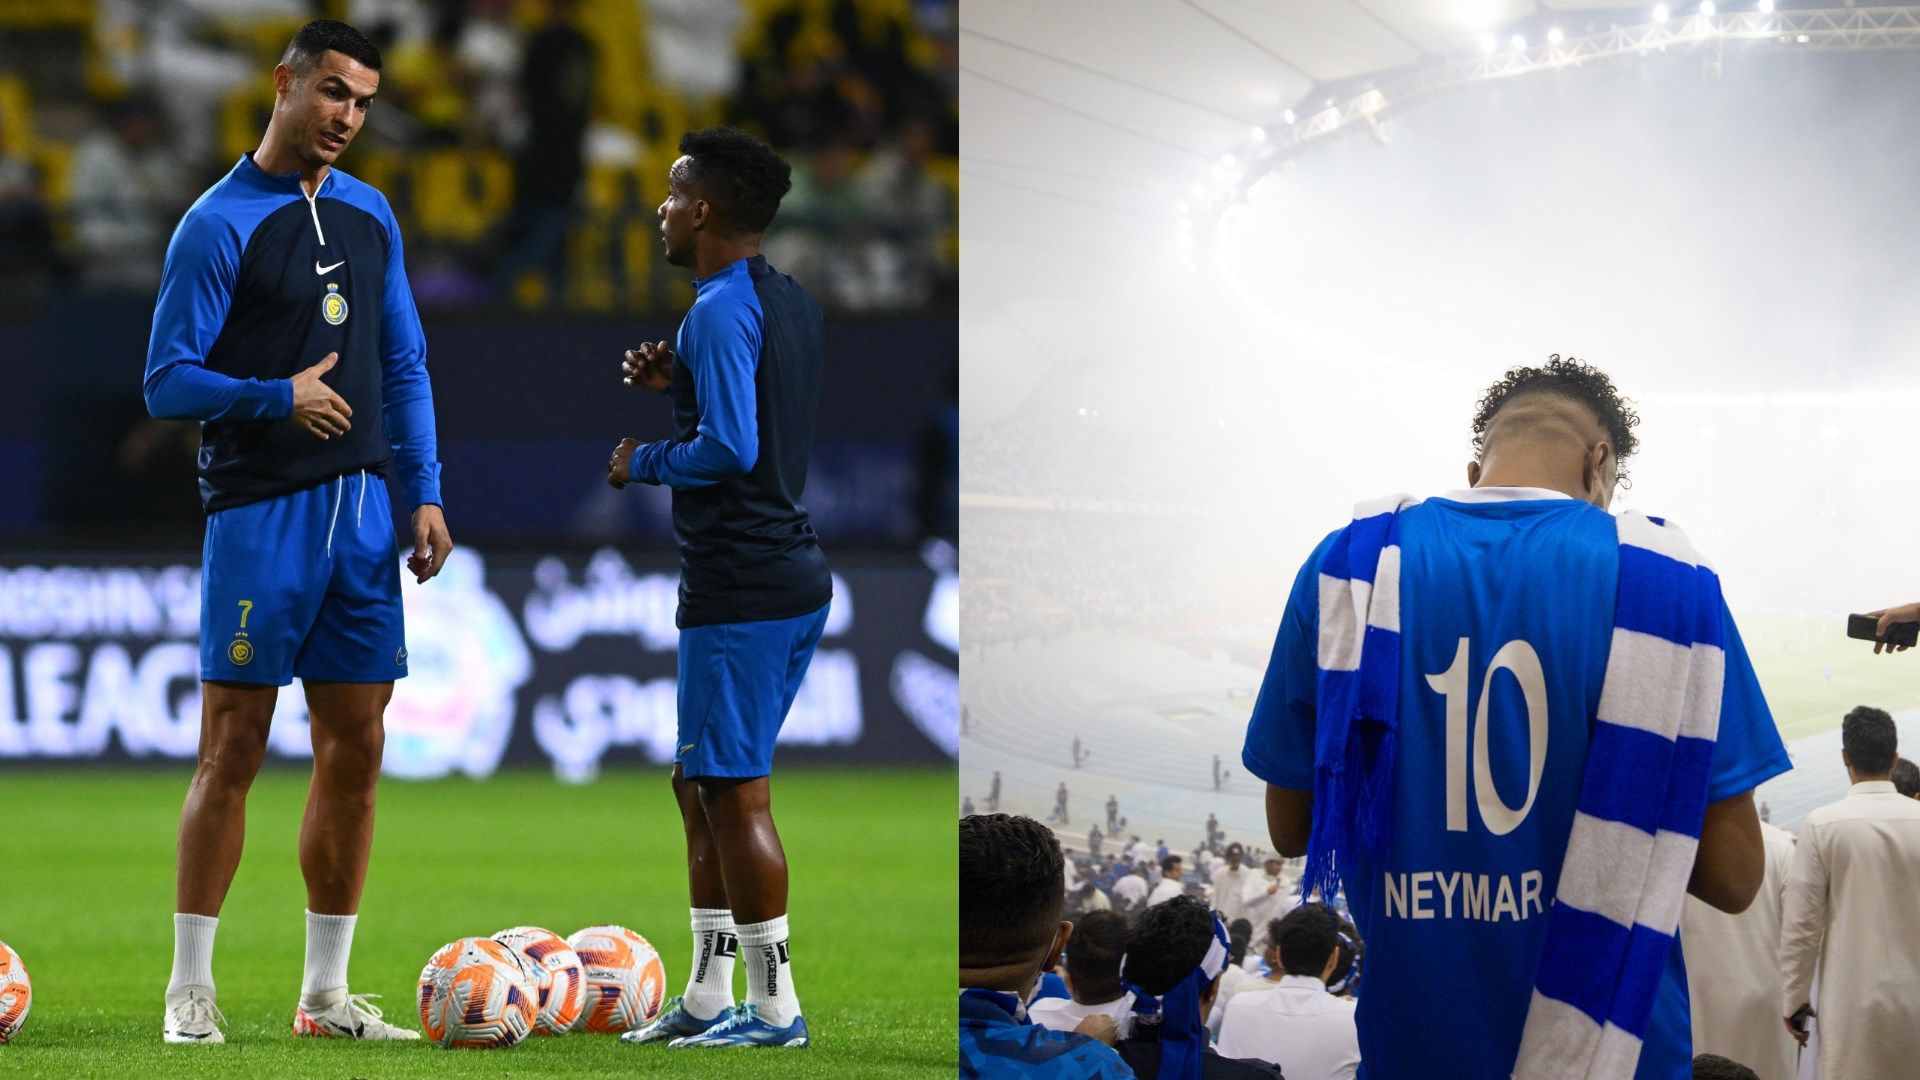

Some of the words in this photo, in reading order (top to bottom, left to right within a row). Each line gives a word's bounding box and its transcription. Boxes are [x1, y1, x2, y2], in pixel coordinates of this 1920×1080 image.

[238, 600, 253, 628] 7
[1424, 637, 1549, 836] 10
[1385, 869, 1543, 922] NEYMAR
[695, 932, 713, 984] TAPEDESIGN
[763, 945, 777, 997] TAPEDESIGN
